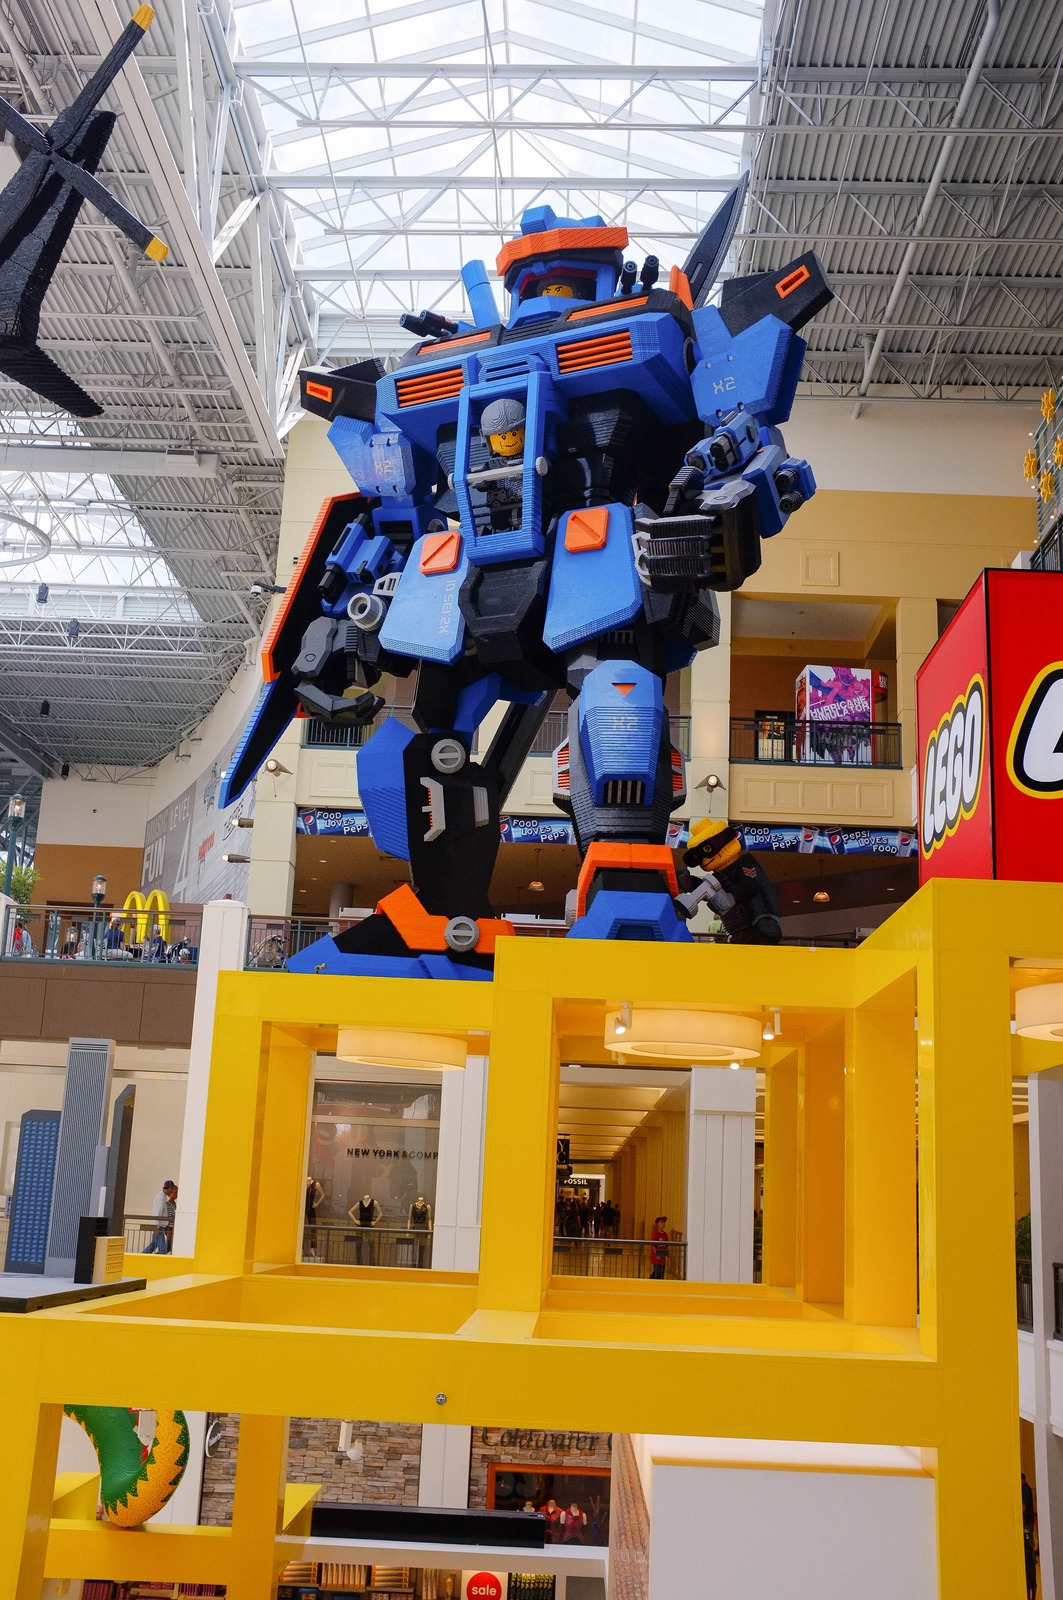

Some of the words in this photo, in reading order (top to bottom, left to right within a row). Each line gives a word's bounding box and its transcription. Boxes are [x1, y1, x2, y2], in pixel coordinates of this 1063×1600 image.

[712, 376, 736, 395] X2
[810, 695, 866, 718] HURRICANE
[812, 701, 870, 721] SIMULATOR
[924, 690, 982, 845] LEGO
[169, 795, 190, 831] LEVEL
[316, 811, 342, 820] FOOD
[324, 817, 355, 828] LOVES
[343, 821, 369, 835] Peps
[512, 819, 538, 828] FOOD
[521, 825, 552, 836] LOVES
[744, 826, 770, 835] FOOD
[753, 833, 783, 844] LOVES
[858, 836, 888, 847] LOVES
[872, 845, 897, 854] FOOD
[141, 835, 167, 887] FUN
[347, 1148, 370, 1157] NEW
[372, 1149, 400, 1158] YORK
[471, 1584, 497, 1596] sale
